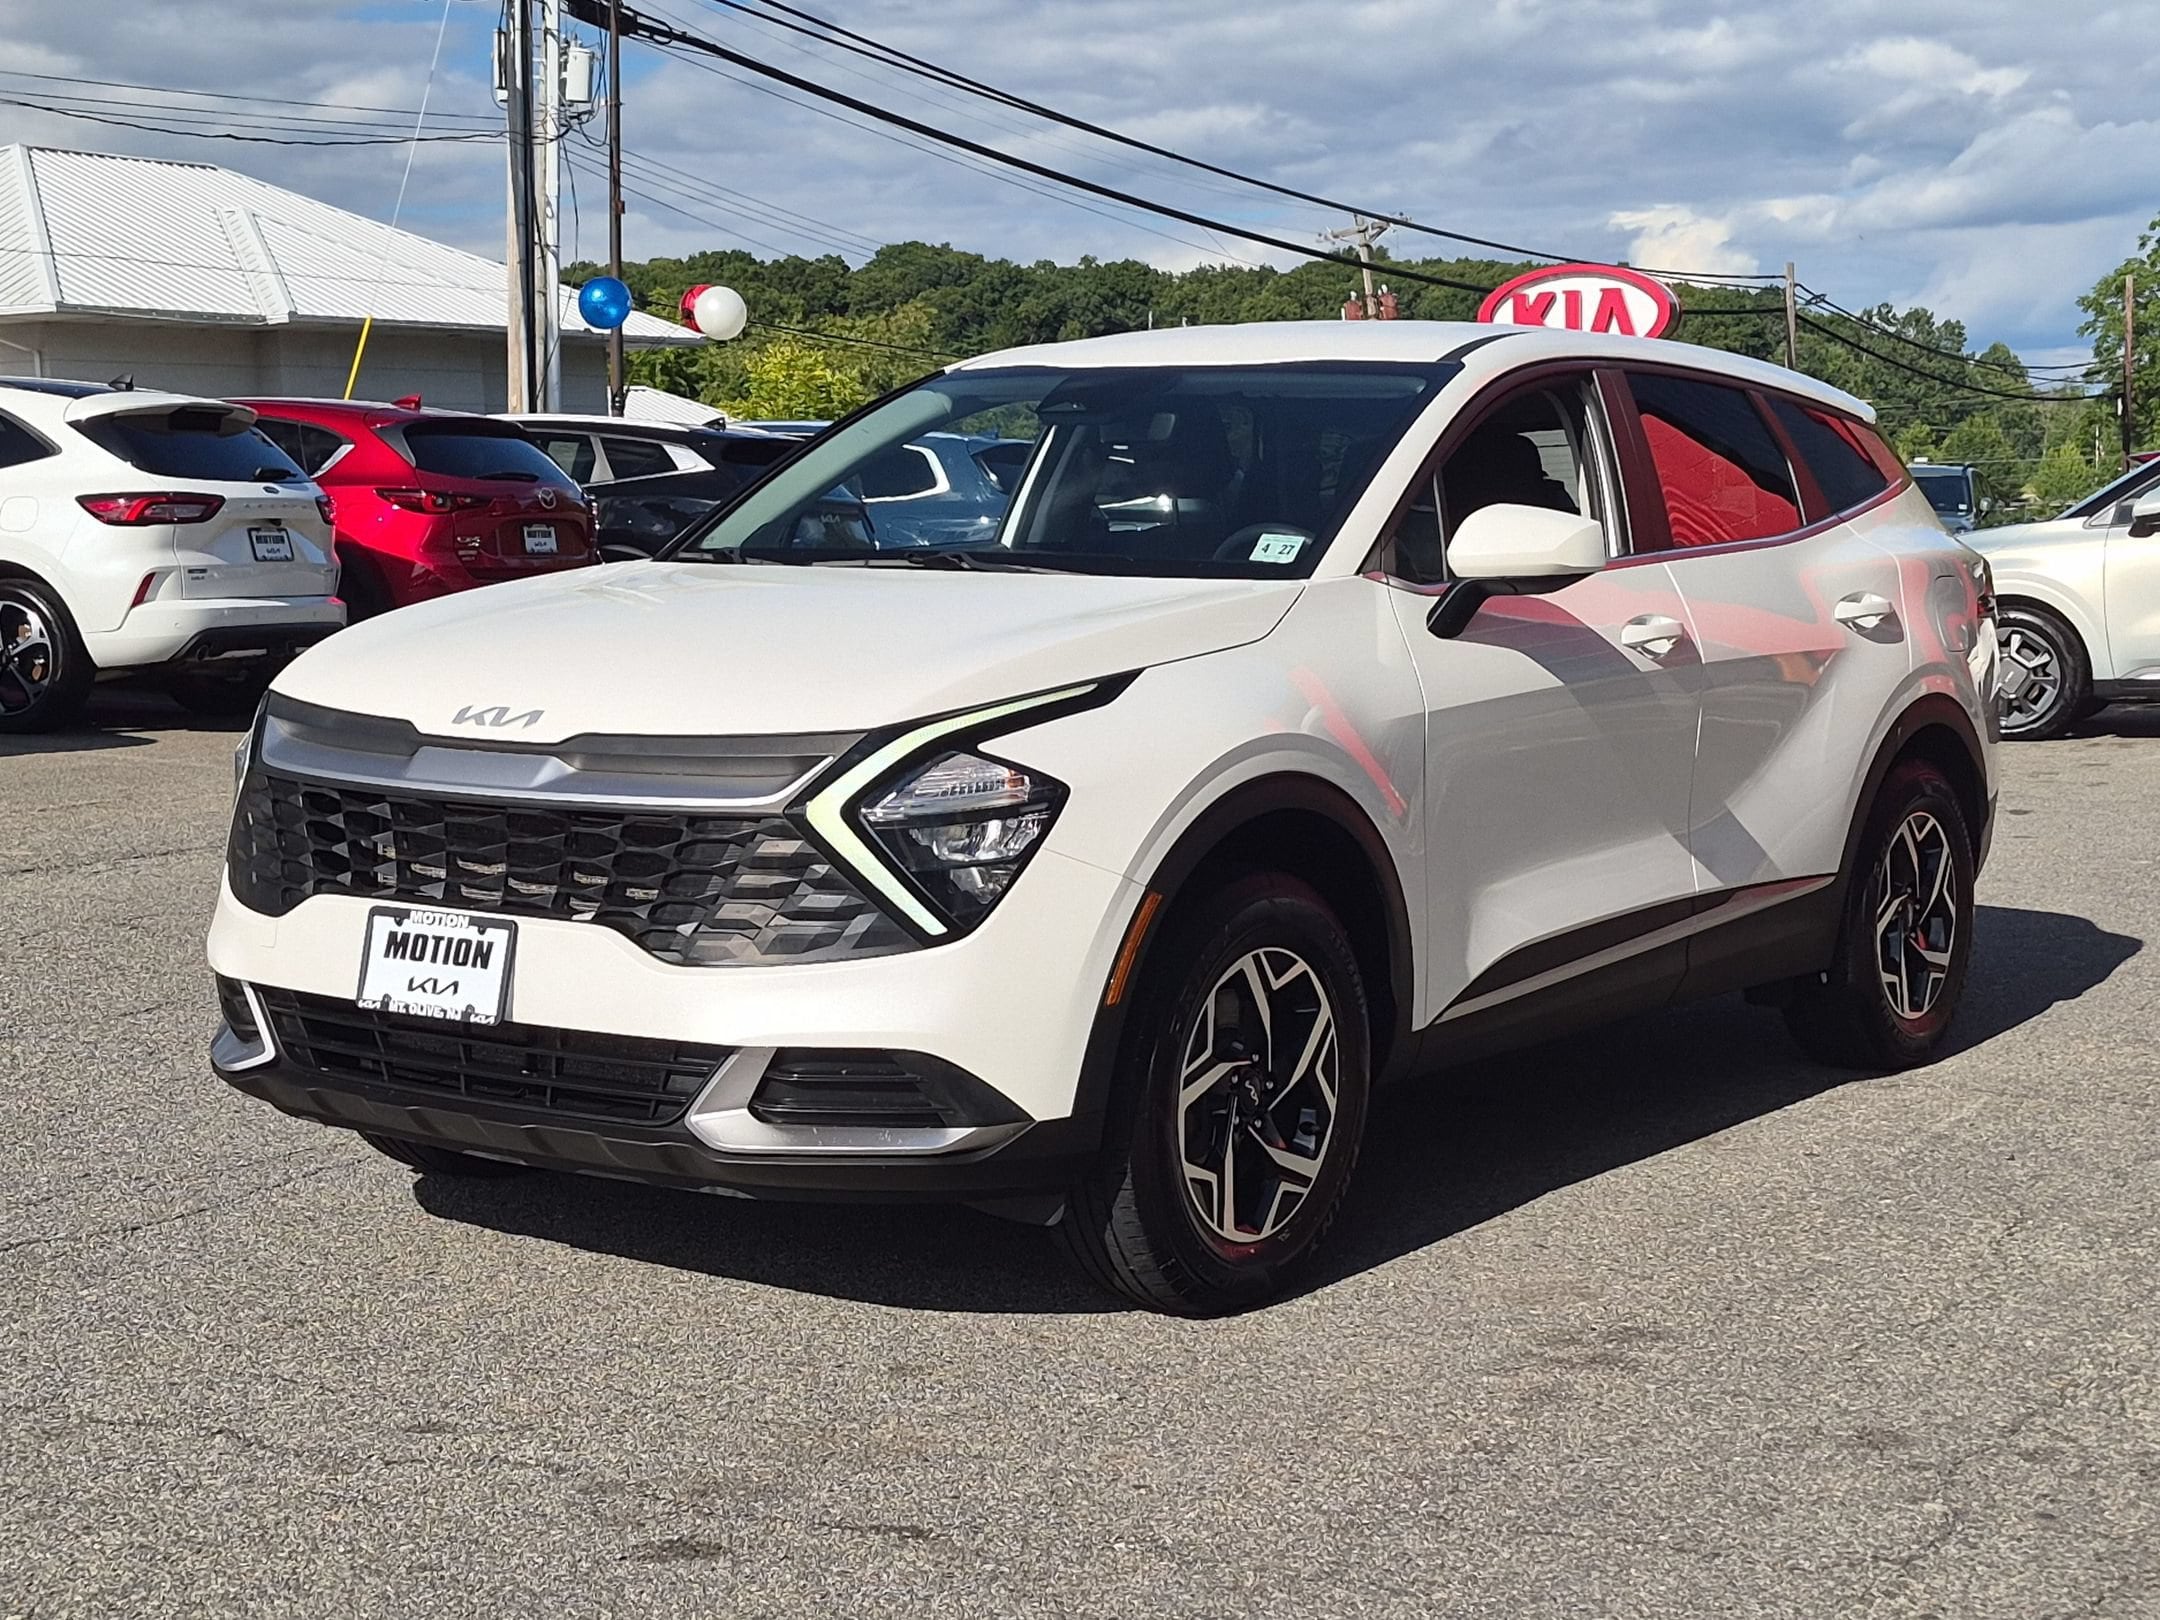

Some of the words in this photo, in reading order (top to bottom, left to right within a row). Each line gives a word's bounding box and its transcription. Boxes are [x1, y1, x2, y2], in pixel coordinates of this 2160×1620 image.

[1511, 288, 1637, 336] KIA
[1261, 543, 1271, 553] 4
[1278, 544, 1296, 555] 27
[451, 705, 545, 729] KIA
[409, 910, 470, 929] MOTION
[383, 930, 495, 970] MOTION
[407, 976, 459, 996] KIA
[446, 1007, 462, 1020] NJ
